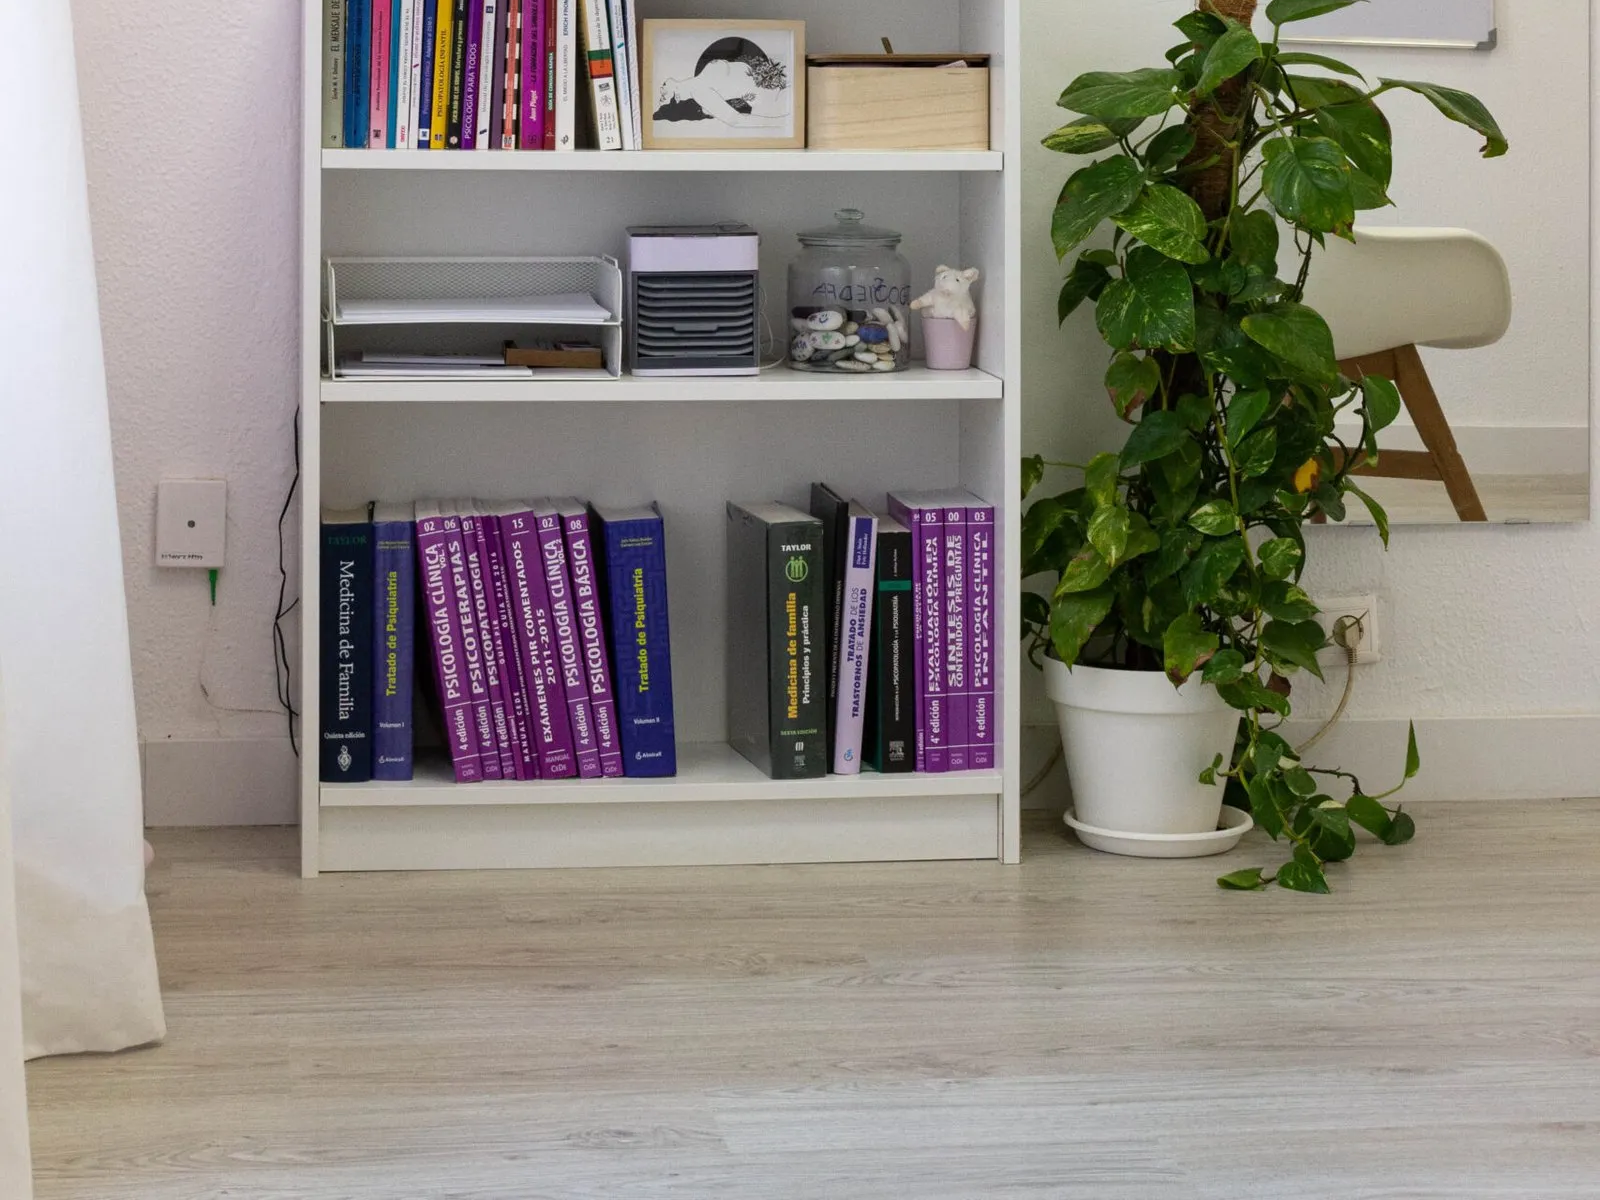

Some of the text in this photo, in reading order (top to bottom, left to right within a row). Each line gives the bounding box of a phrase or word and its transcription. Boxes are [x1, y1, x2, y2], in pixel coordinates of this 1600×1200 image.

[330, 0, 340, 9] DE
[330, 11, 340, 42] MENSAJE
[330, 43, 340, 52] EL
[435, 28, 447, 117] PSICOPATOLOGÍA INFANTIL
[463, 42, 477, 139] PSICOLOGÍA PARA TODOS
[424, 521, 436, 532] 02
[444, 519, 456, 529] 06
[463, 520, 474, 531] 01
[512, 518, 524, 529] 15
[542, 517, 554, 528] 02
[570, 519, 582, 530] 08
[925, 512, 937, 522] 05
[948, 511, 960, 522] 00
[974, 511, 985, 522] 03
[781, 543, 812, 552] TAYLOR
[954, 534, 962, 603] PREGUNTAS
[489, 550, 509, 628] GUÍA PIR 2016
[891, 594, 899, 629] PSIQUIATRÍA
[945, 534, 957, 687] SÍNTESIS DE
[972, 531, 981, 687] PSICOLOGÍA CLÍNICA
[385, 570, 399, 696] Tratado de Psiquiatría
[423, 542, 461, 700] PSICOLOGÍA CLÍNICA
[447, 539, 484, 694] PSICOTERAPIAS
[466, 550, 499, 686] PSICOPATOLOGÍA
[543, 538, 580, 688] PSICOLOGÍA CLÍNICA
[571, 538, 606, 694] PSICOLOGÍA BÁSICA
[631, 567, 649, 692] Tratado de Psiquiatría
[799, 604, 810, 645] práctica
[846, 586, 859, 662] TRATADO DE LOS
[924, 538, 935, 692] EVALUACIÓN EN
[930, 536, 940, 692] PSICOLOGÍA CLÍNICA
[337, 559, 355, 721] Medicina de Familia
[491, 618, 506, 665] GUÍA PIR
[510, 538, 553, 743] EXÁMENES PIR COMENTADOS
[535, 607, 557, 685] 2011-2015
[785, 591, 798, 718] Medicina de familia
[851, 587, 867, 718] TRASTORNOS DE ANSIEDAD
[891, 639, 899, 685] PSICOPATOLOGÍA
[954, 614, 963, 687] CONTENIDOS
[801, 655, 811, 704] Principios
[452, 708, 468, 743] edición
[475, 705, 491, 740] edición
[492, 706, 508, 741] edición
[512, 690, 531, 762] MANUAL CEDE
[573, 703, 589, 738] edición
[595, 705, 611, 741] edición
[929, 699, 940, 733] edición
[975, 696, 986, 730] edición
[545, 754, 569, 763] MANUAL
